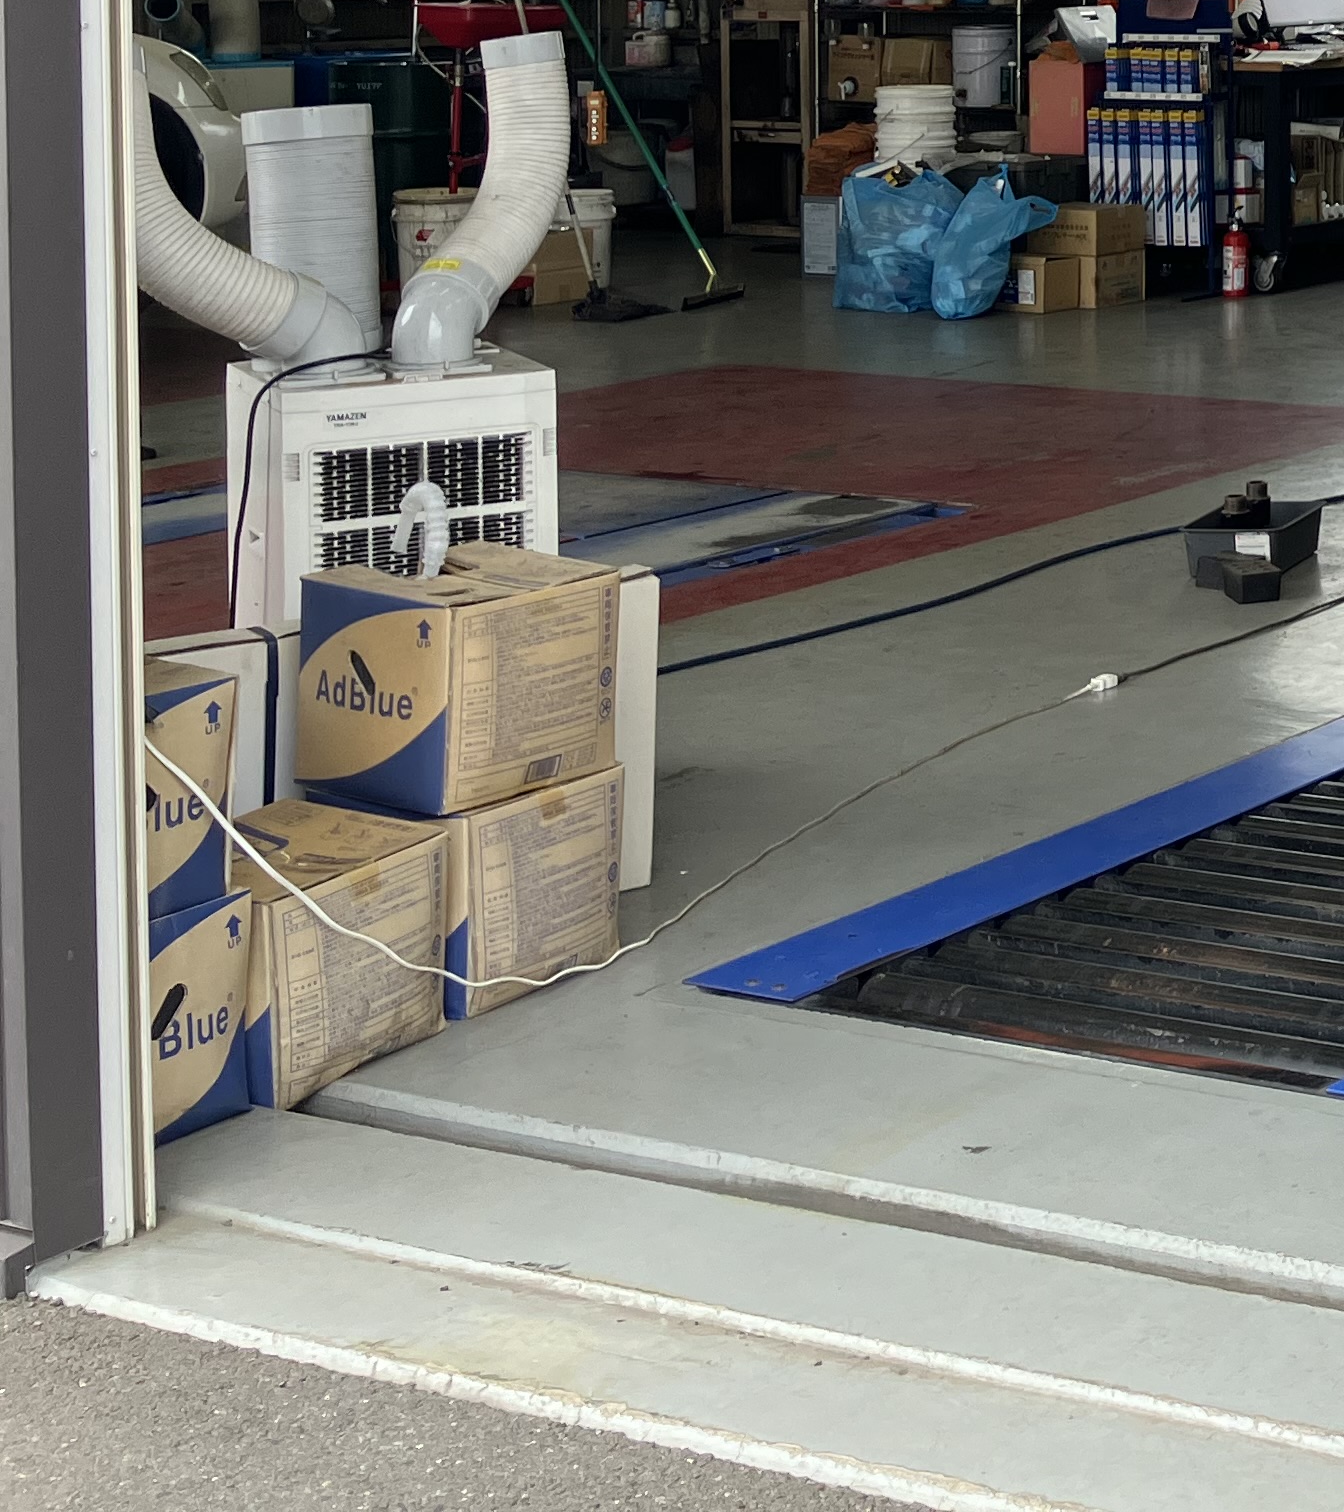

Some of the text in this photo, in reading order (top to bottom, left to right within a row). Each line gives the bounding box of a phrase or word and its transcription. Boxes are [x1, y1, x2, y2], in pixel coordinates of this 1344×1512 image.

[326, 412, 367, 422] YAMAZEN
[416, 639, 432, 648] UP
[315, 669, 413, 720] AdBlue
[205, 722, 221, 735] UP
[146, 792, 205, 832] lue
[228, 936, 242, 949] UP
